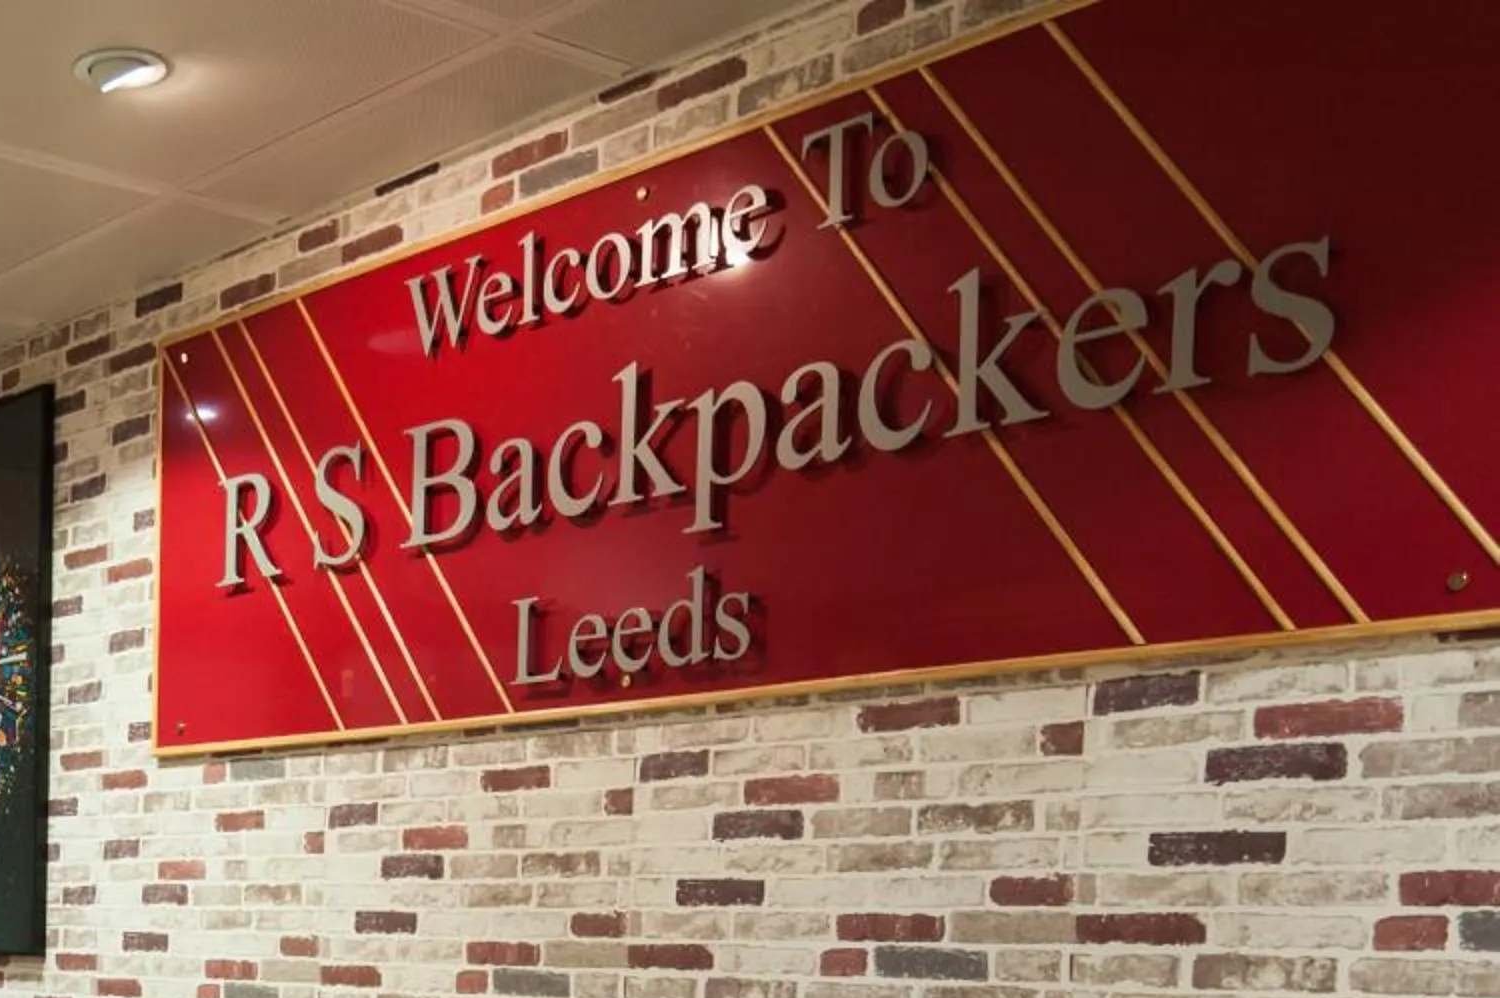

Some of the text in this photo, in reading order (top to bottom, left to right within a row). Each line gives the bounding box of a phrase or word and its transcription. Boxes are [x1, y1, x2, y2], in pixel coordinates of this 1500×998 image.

[405, 112, 931, 357] Welcome To
[215, 236, 1335, 588] R S Backpackers
[510, 566, 753, 686] Leeds
